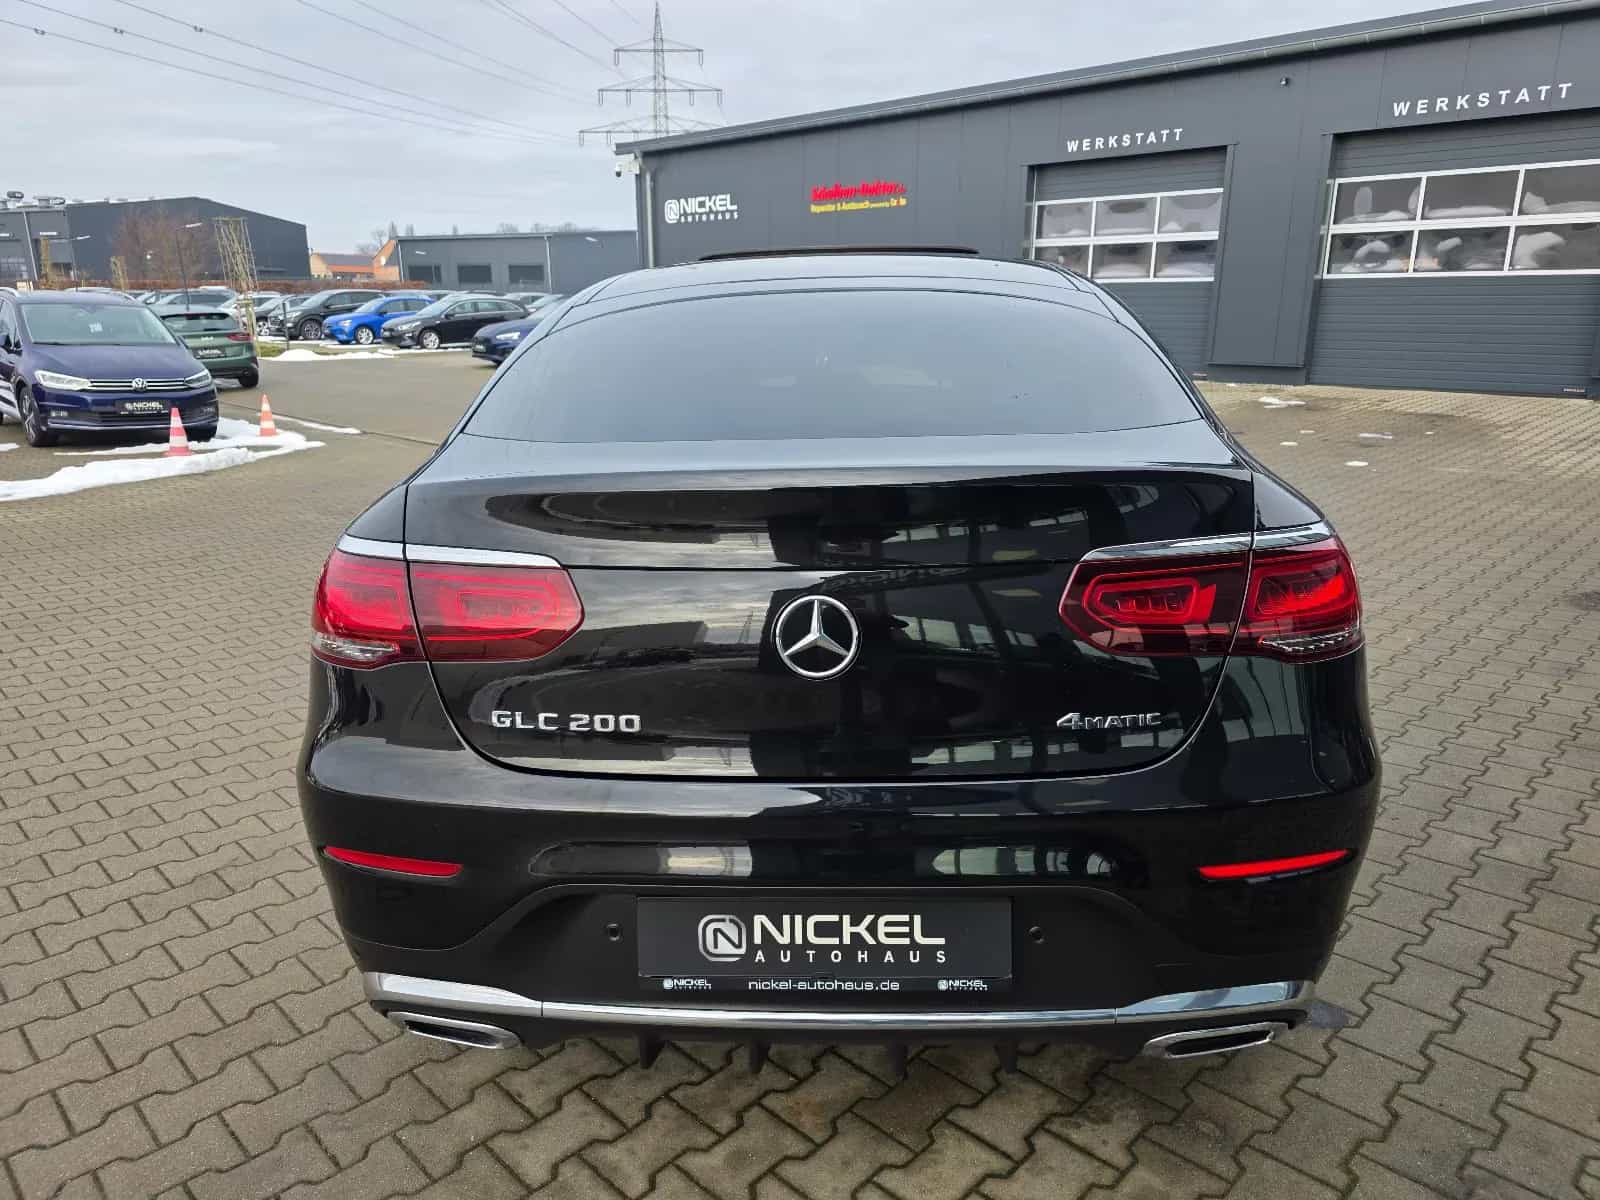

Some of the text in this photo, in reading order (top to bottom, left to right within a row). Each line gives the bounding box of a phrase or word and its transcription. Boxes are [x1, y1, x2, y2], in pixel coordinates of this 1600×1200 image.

[1393, 83, 1572, 117] WERKSTATT
[1066, 127, 1183, 153] WERKSTATT
[680, 193, 738, 214] NICKEL
[491, 710, 641, 733] GLC 200
[1056, 712, 1161, 730] 4MATIC
[753, 914, 946, 945] NICKEL
[754, 950, 947, 963] AUTOHAUS
[673, 978, 712, 986] NICKEL
[748, 979, 900, 991] nickel-autohaus.de
[948, 979, 988, 988] NICKEL
